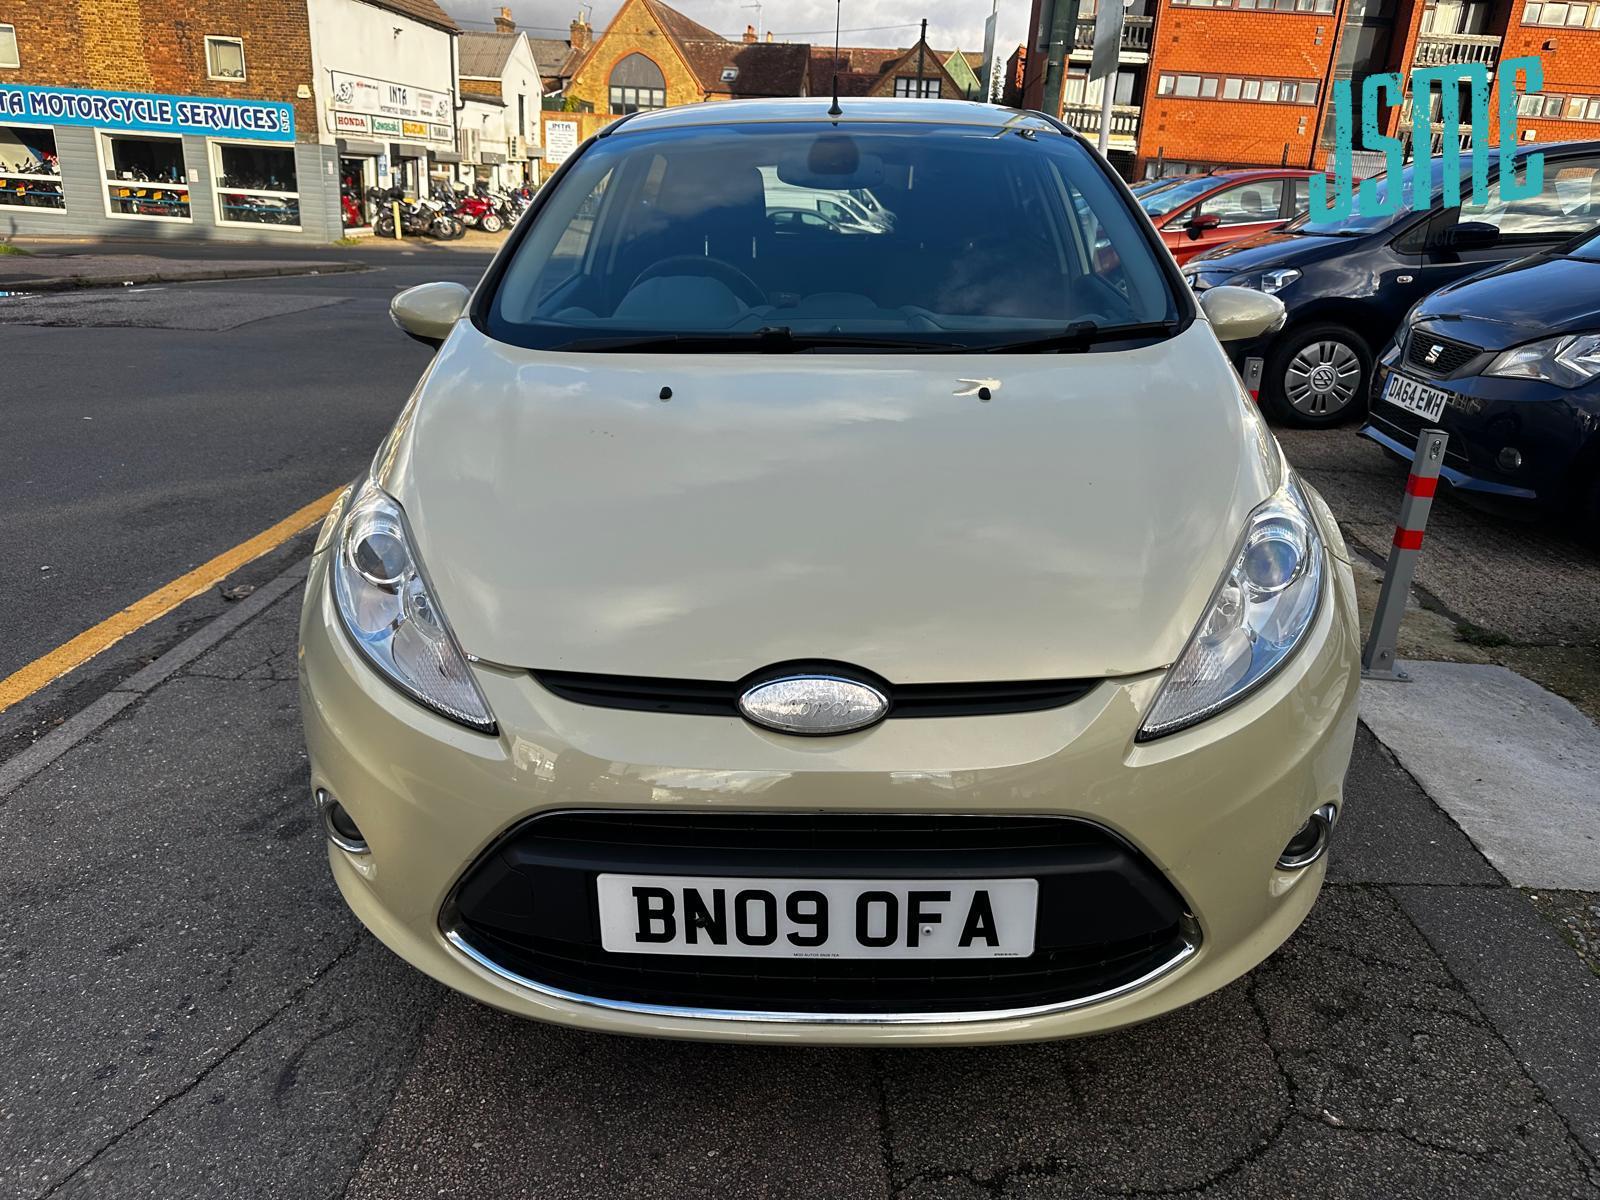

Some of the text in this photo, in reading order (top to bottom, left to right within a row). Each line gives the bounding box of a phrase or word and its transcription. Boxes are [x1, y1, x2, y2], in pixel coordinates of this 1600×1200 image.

[389, 85, 407, 105] INTA
[29, 93, 172, 123] MOTORCYCLE
[177, 103, 279, 131] SERVICES
[281, 110, 290, 132] LTD
[337, 116, 365, 127] HONDA
[1388, 377, 1445, 417] DA64 EWH
[632, 886, 1000, 947] BN09 OFA
